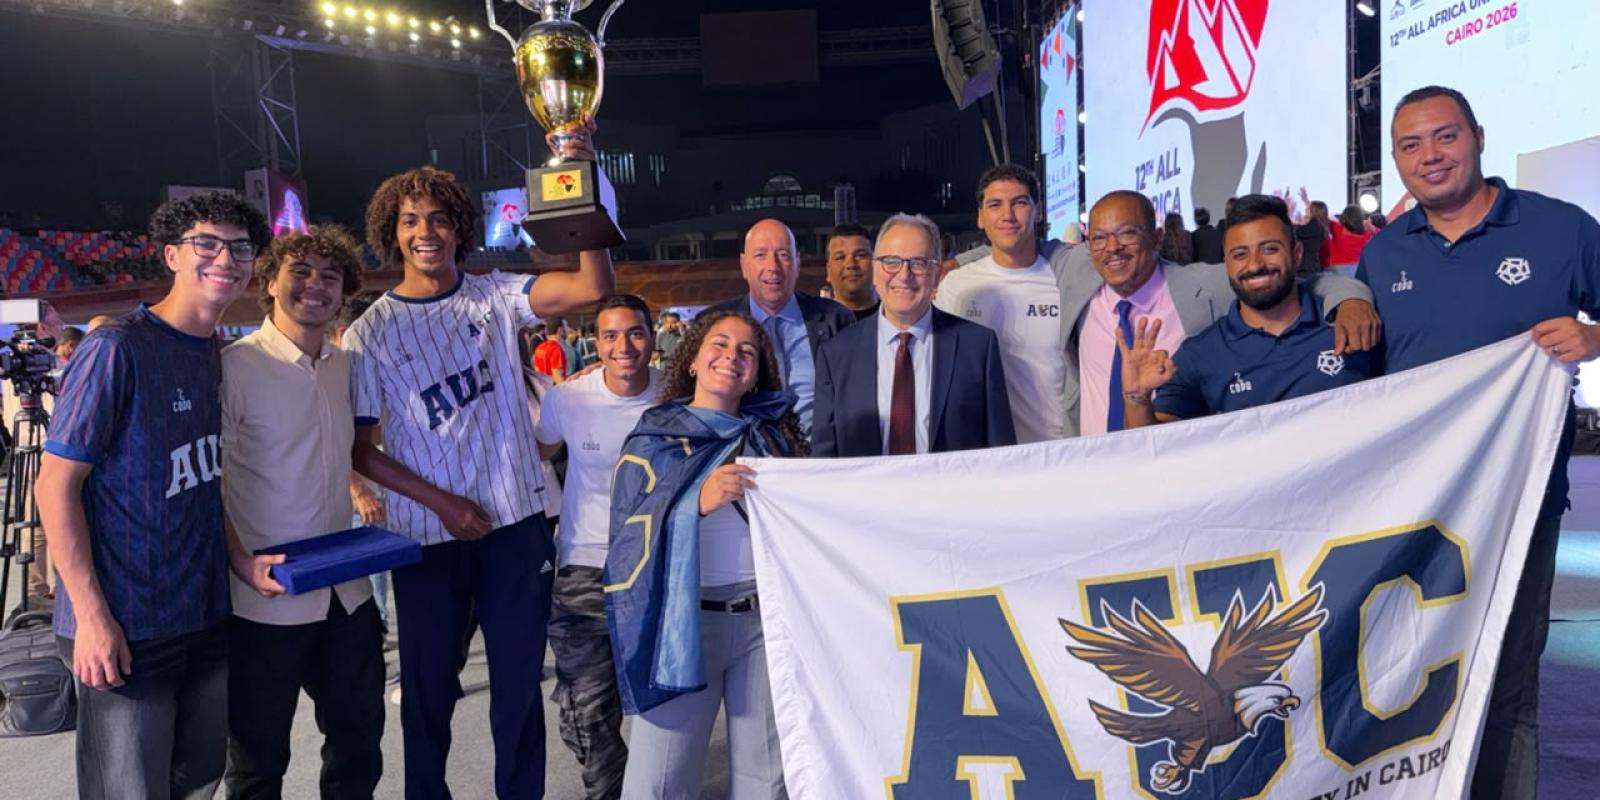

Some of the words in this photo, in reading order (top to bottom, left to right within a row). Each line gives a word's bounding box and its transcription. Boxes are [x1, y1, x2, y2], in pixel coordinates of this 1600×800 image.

[1407, 21, 1425, 40] ALL
[1427, 2, 1466, 30] AFRICA
[1469, 0, 1490, 11] UN
[1445, 18, 1483, 45] CAIRO
[1486, 2, 1518, 29] 2026
[1155, 147, 1181, 184] ALL
[165, 434, 222, 499] AU
[884, 518, 1471, 800] AUC
[1345, 771, 1373, 800] IN
